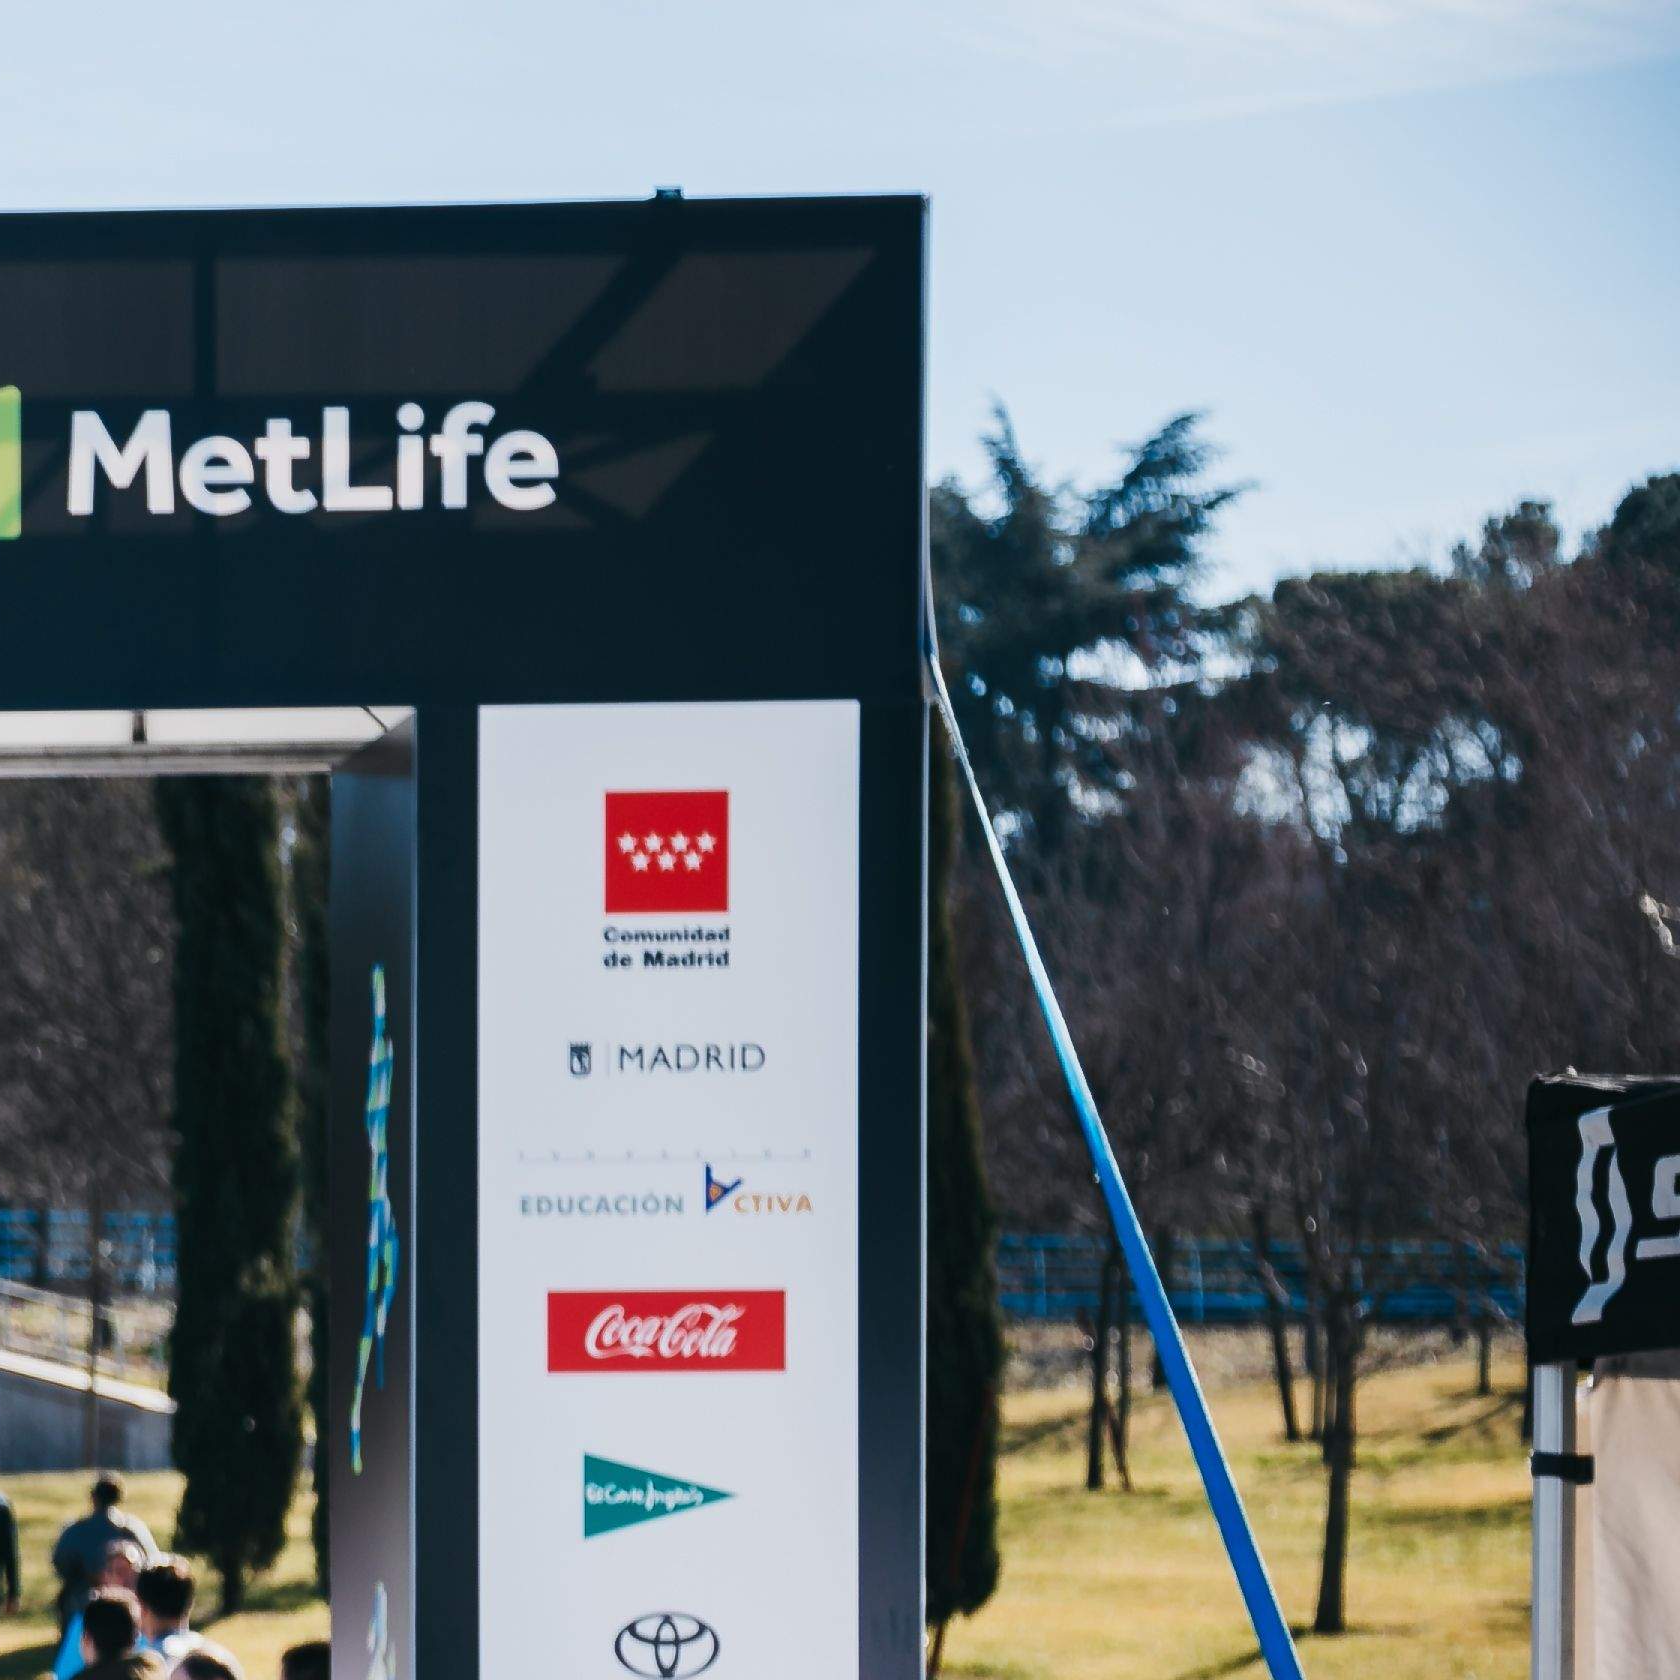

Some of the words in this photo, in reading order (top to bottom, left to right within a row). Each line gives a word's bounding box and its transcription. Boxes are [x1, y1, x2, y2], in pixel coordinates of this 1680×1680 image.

[67, 400, 560, 517] MetLife
[602, 925, 731, 944] Comunidad
[603, 950, 633, 968] de
[642, 949, 731, 968] Madrid
[618, 1043, 767, 1073] MADRID
[520, 1189, 685, 1216] EDUCACIÓN
